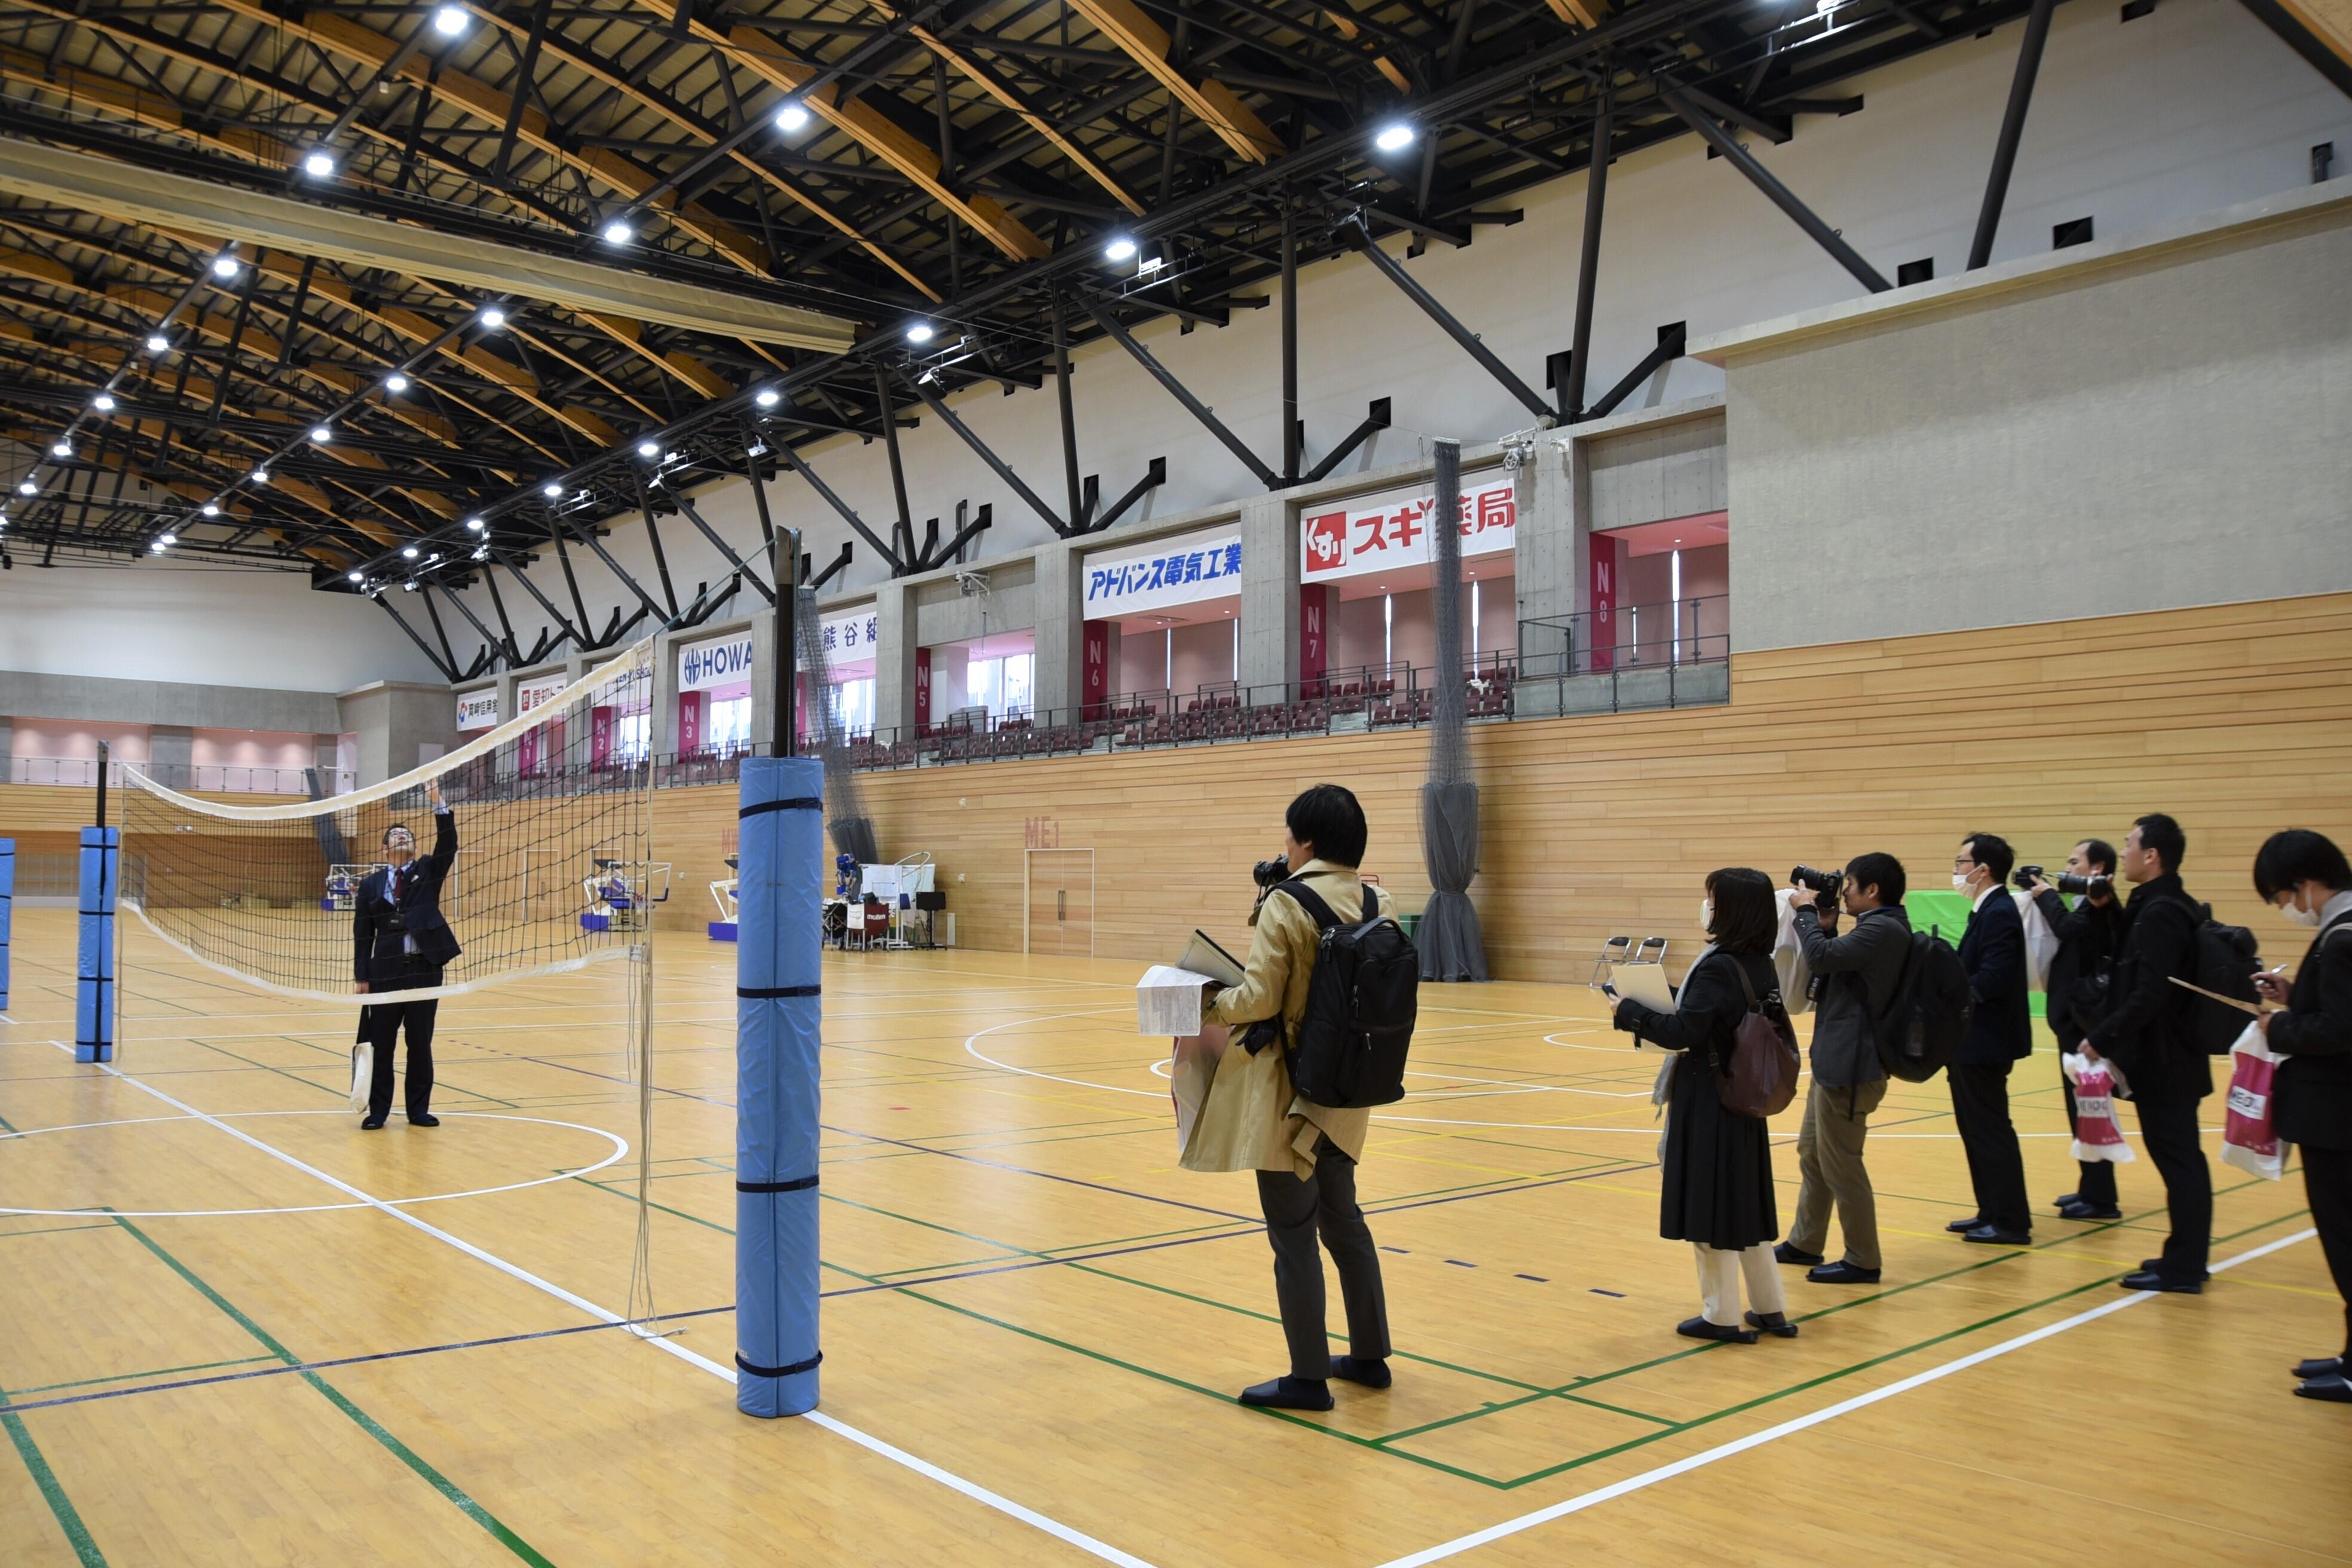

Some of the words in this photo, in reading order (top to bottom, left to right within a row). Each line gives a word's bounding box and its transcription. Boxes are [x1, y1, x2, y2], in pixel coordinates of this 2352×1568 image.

[1307, 519, 1346, 565] くすり
[1088, 543, 1241, 601] アドバンス電気工業
[1597, 562, 1609, 593] N
[1308, 606, 1319, 633] N
[1090, 640, 1101, 664] N
[1310, 639, 1317, 658] 7
[917, 666, 928, 687] N
[1092, 669, 1099, 686] 6
[919, 691, 926, 707] 5
[685, 705, 694, 722] N
[686, 726, 692, 739] 3
